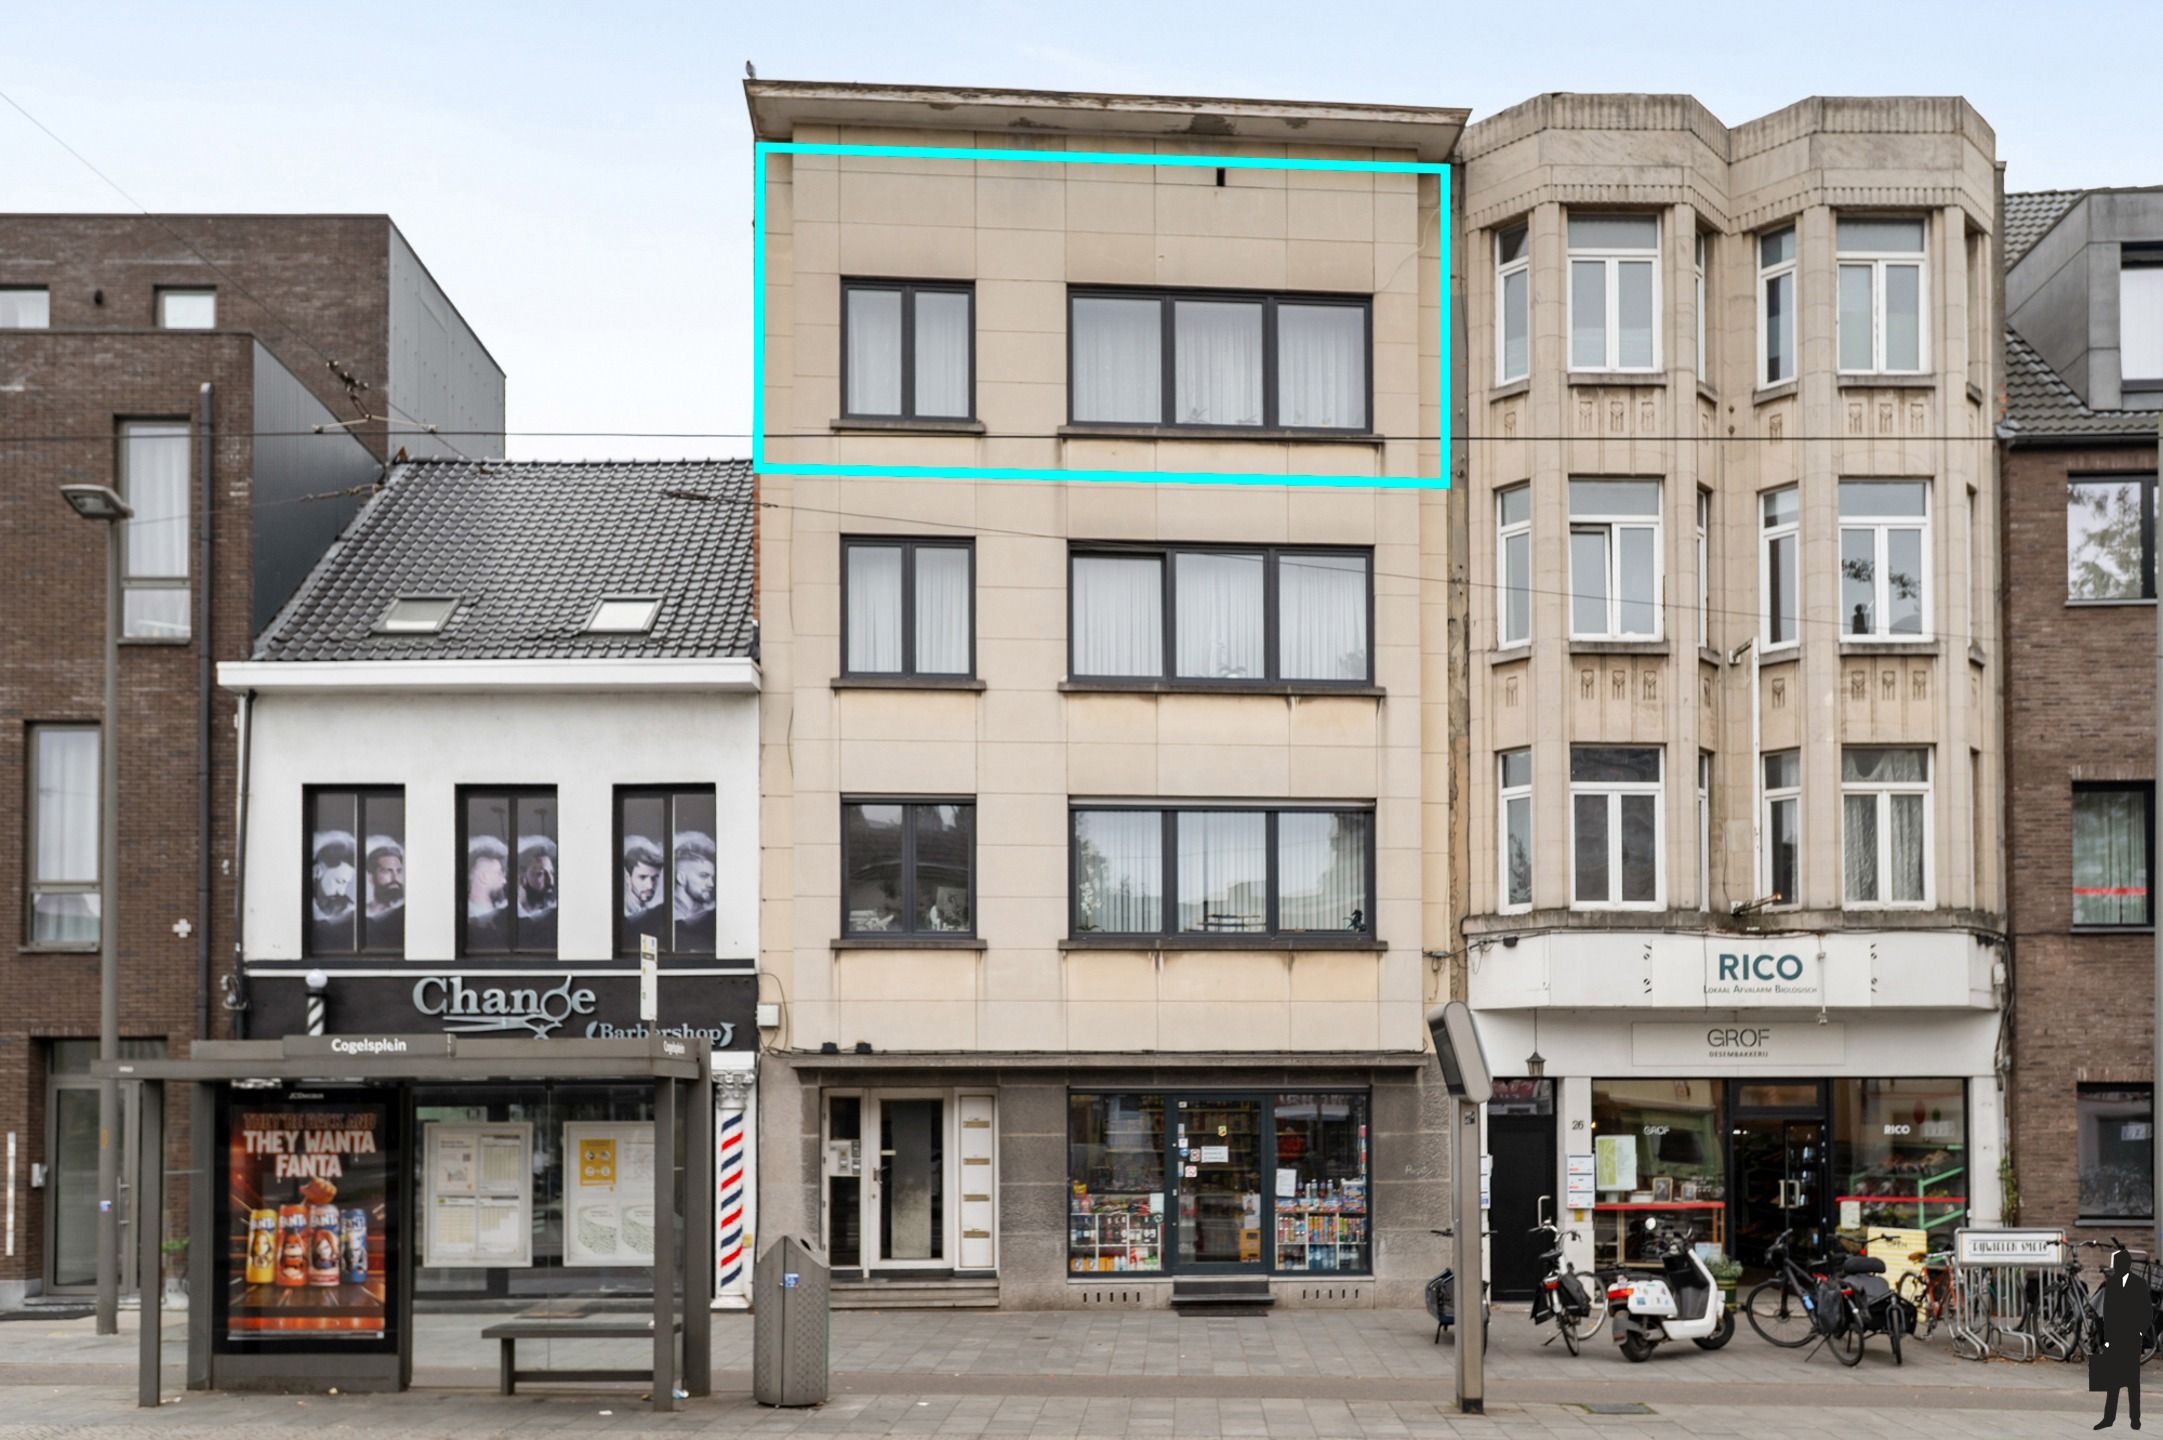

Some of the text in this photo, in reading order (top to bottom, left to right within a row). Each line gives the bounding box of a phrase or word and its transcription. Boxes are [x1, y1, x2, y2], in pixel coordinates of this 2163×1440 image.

[1719, 953, 1804, 981] RICO
[599, 1020, 721, 1046] Barbrshop
[1707, 1028, 1771, 1048] GROF
[331, 1037, 407, 1054] Cogelsplein
[1571, 1119, 1584, 1131] 26
[1883, 1124, 1911, 1135] RICO
[242, 1130, 376, 1154] THEY WANTA
[276, 1154, 343, 1178] FANTA
